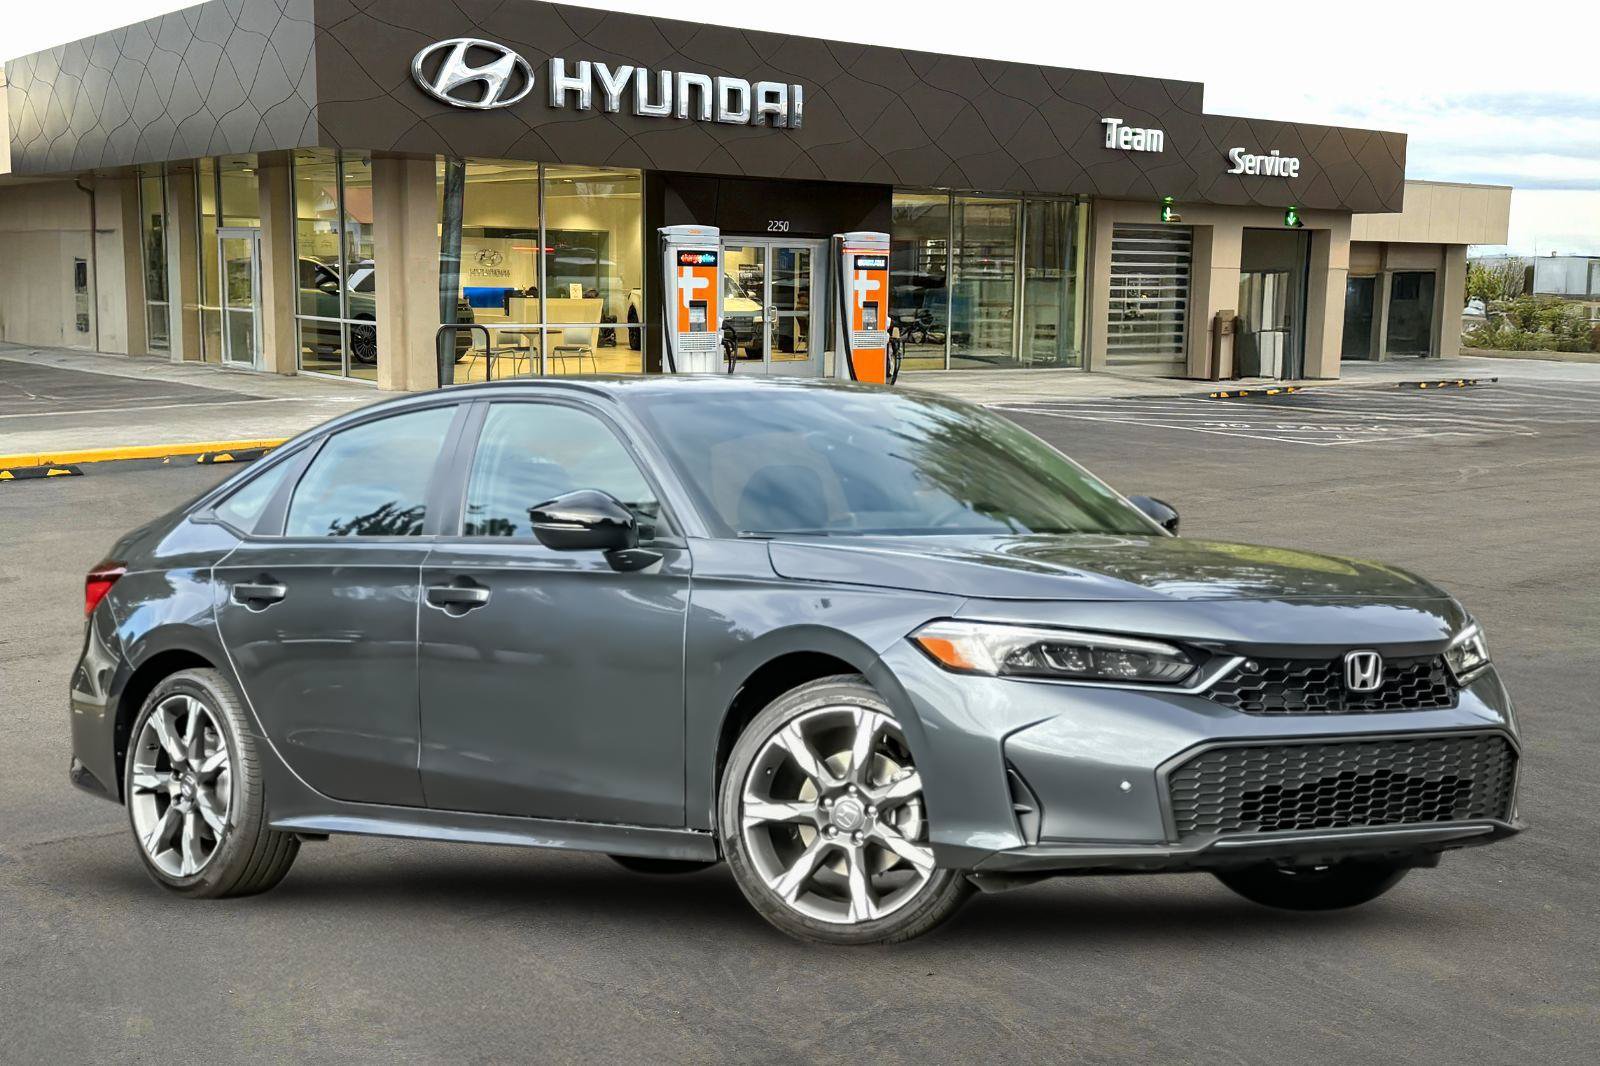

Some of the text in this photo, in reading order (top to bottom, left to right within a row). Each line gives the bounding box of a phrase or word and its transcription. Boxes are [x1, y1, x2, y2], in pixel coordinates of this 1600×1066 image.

[548, 57, 803, 129] HYUNDAI
[1101, 117, 1164, 152] Team
[1227, 147, 1300, 178] Service
[767, 220, 790, 232] 2250
